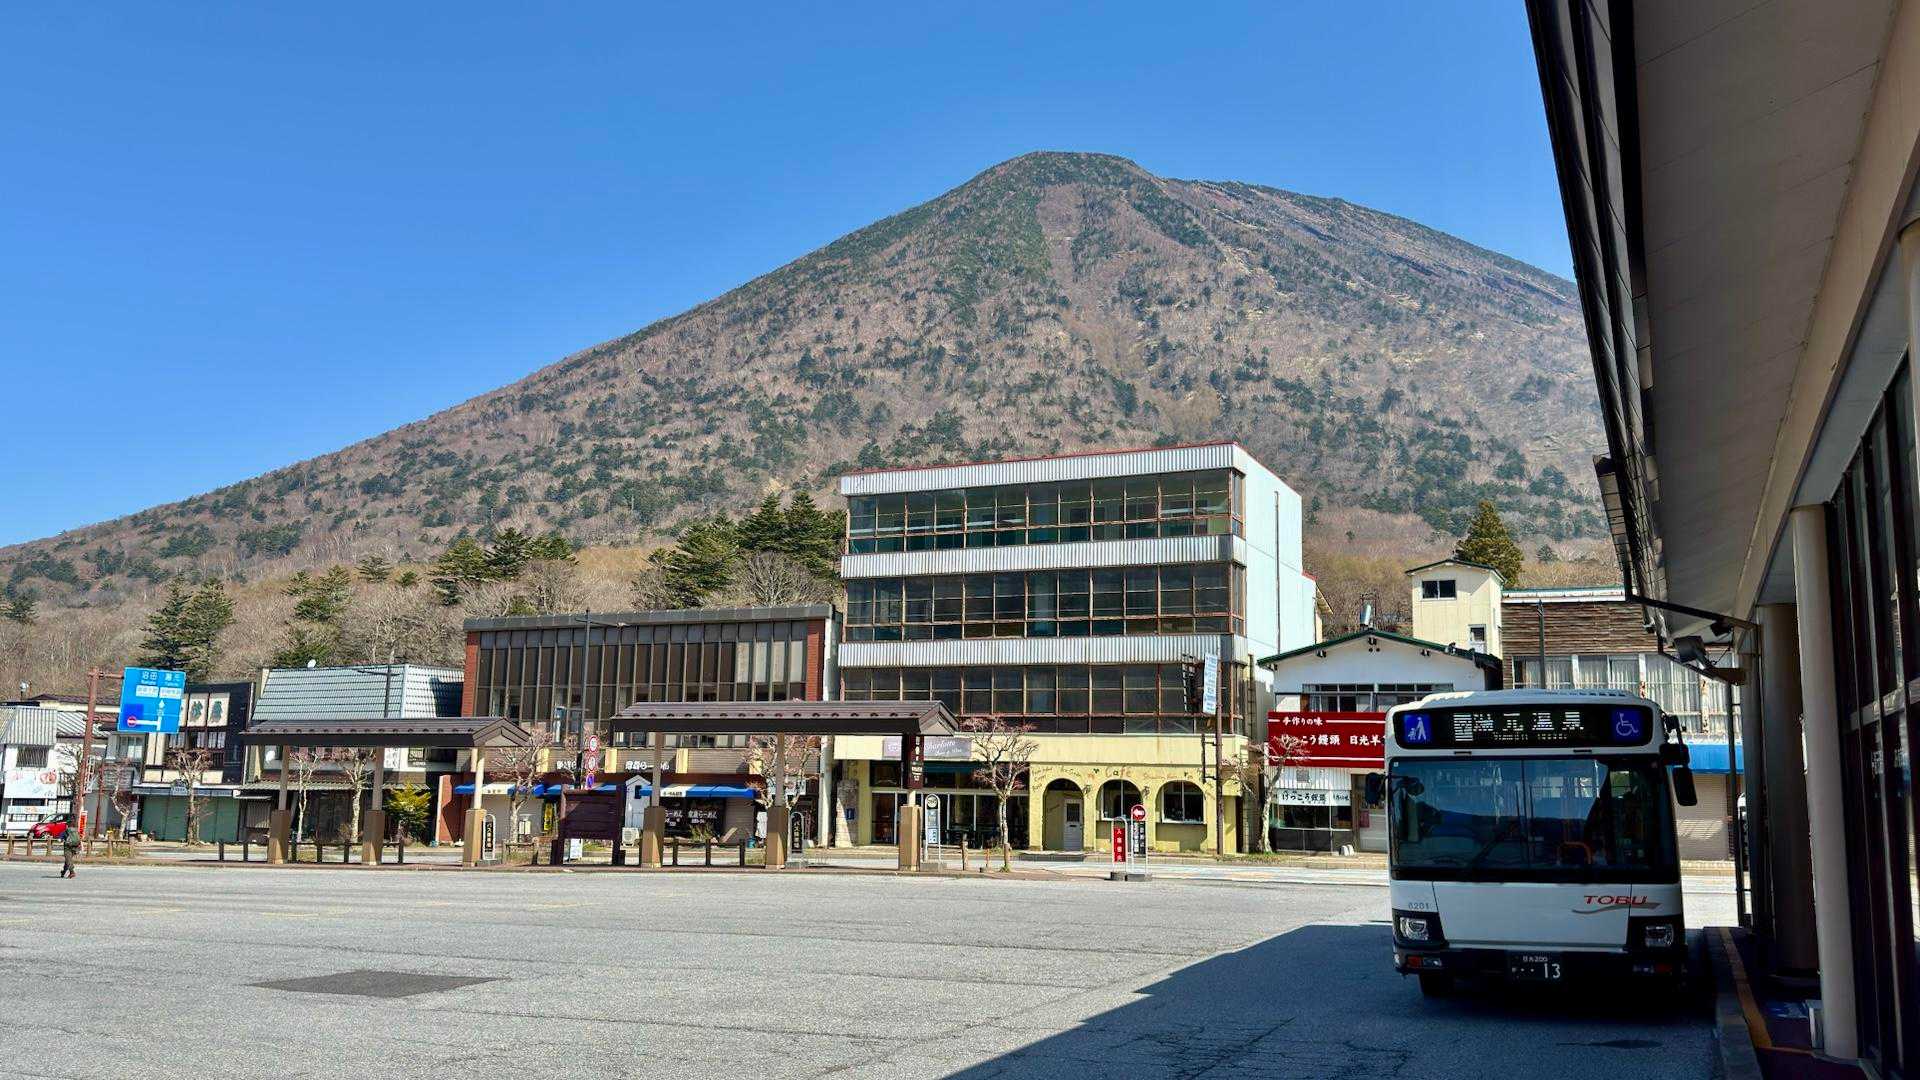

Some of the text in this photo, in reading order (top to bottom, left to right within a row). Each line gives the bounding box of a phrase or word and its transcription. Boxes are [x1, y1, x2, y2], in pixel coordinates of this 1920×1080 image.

[1282, 716, 1323, 726] 手作りの味
[1349, 734, 1386, 746] 日光羊
[1583, 895, 1648, 905] TOBU
